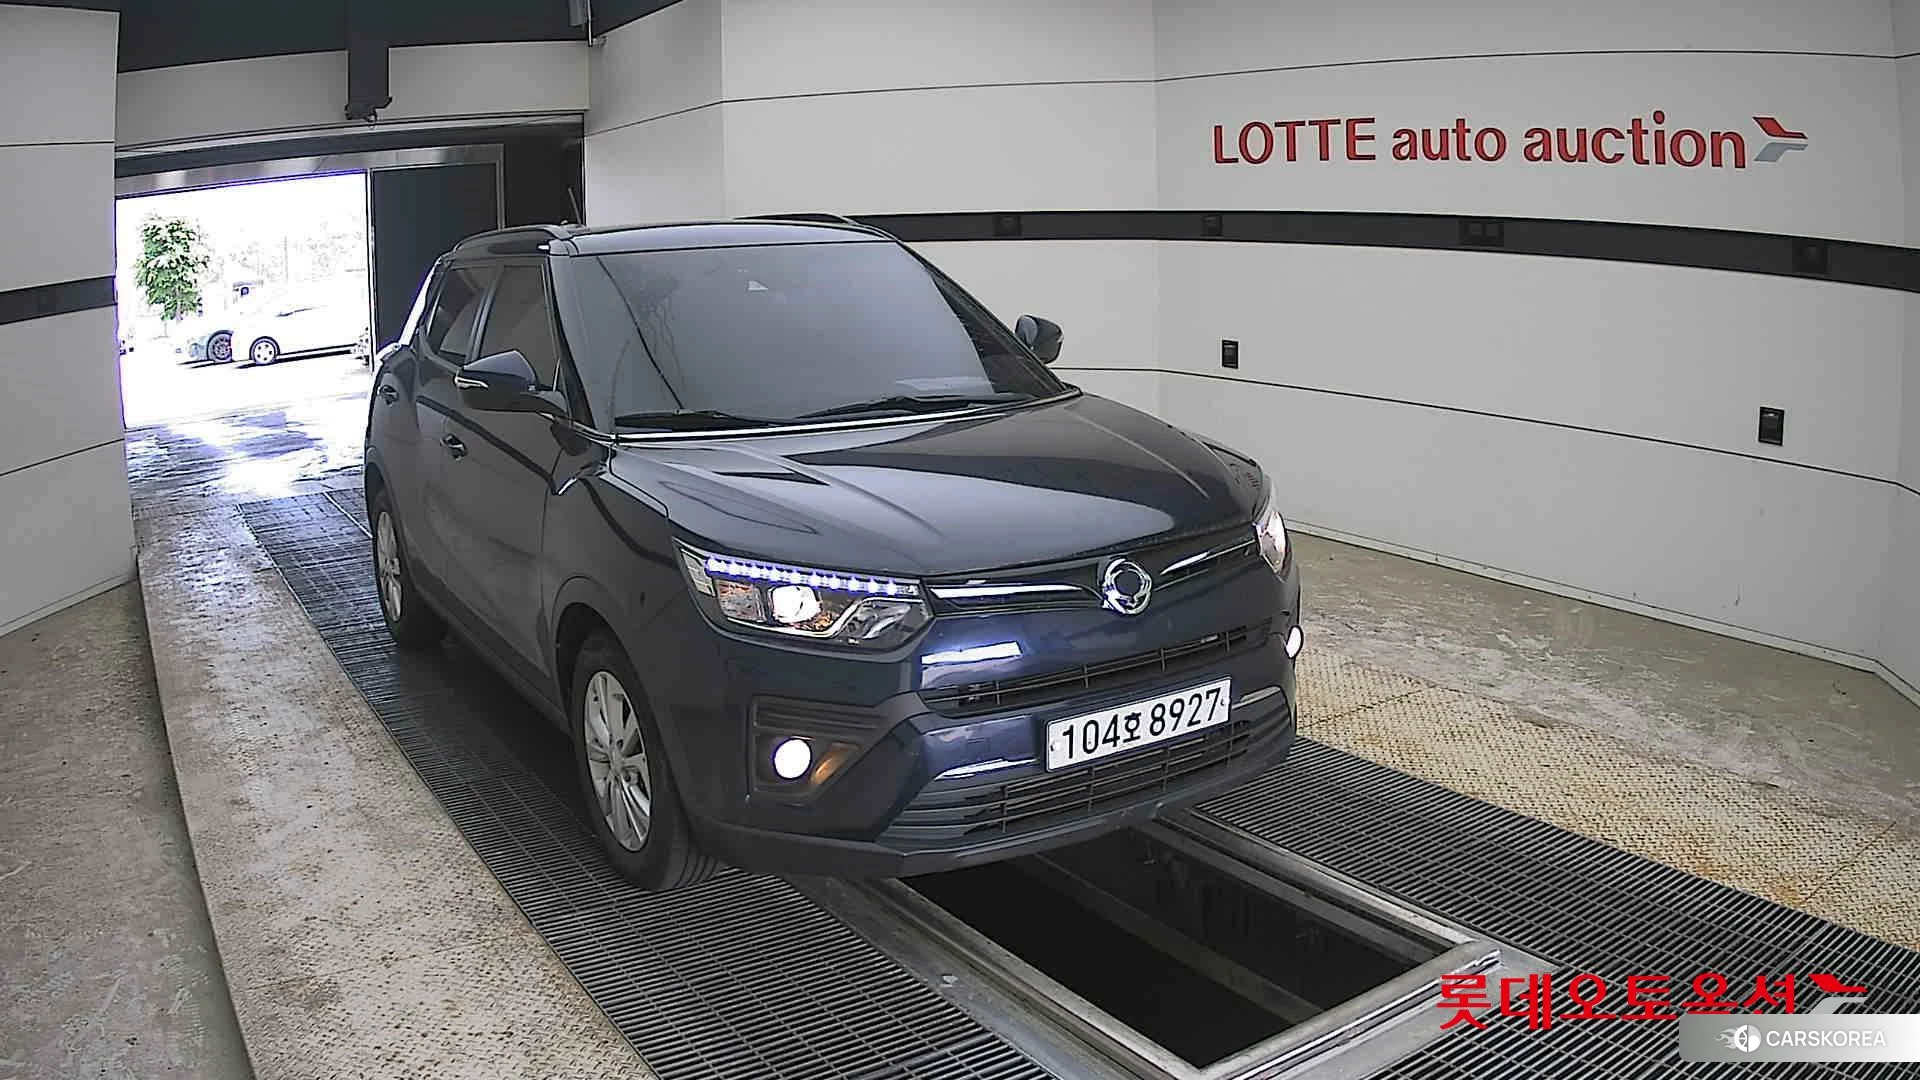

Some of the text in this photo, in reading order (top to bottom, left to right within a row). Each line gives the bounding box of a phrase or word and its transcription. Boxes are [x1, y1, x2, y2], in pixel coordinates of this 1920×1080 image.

[1213, 110, 1747, 169] LOTTE auto auction
